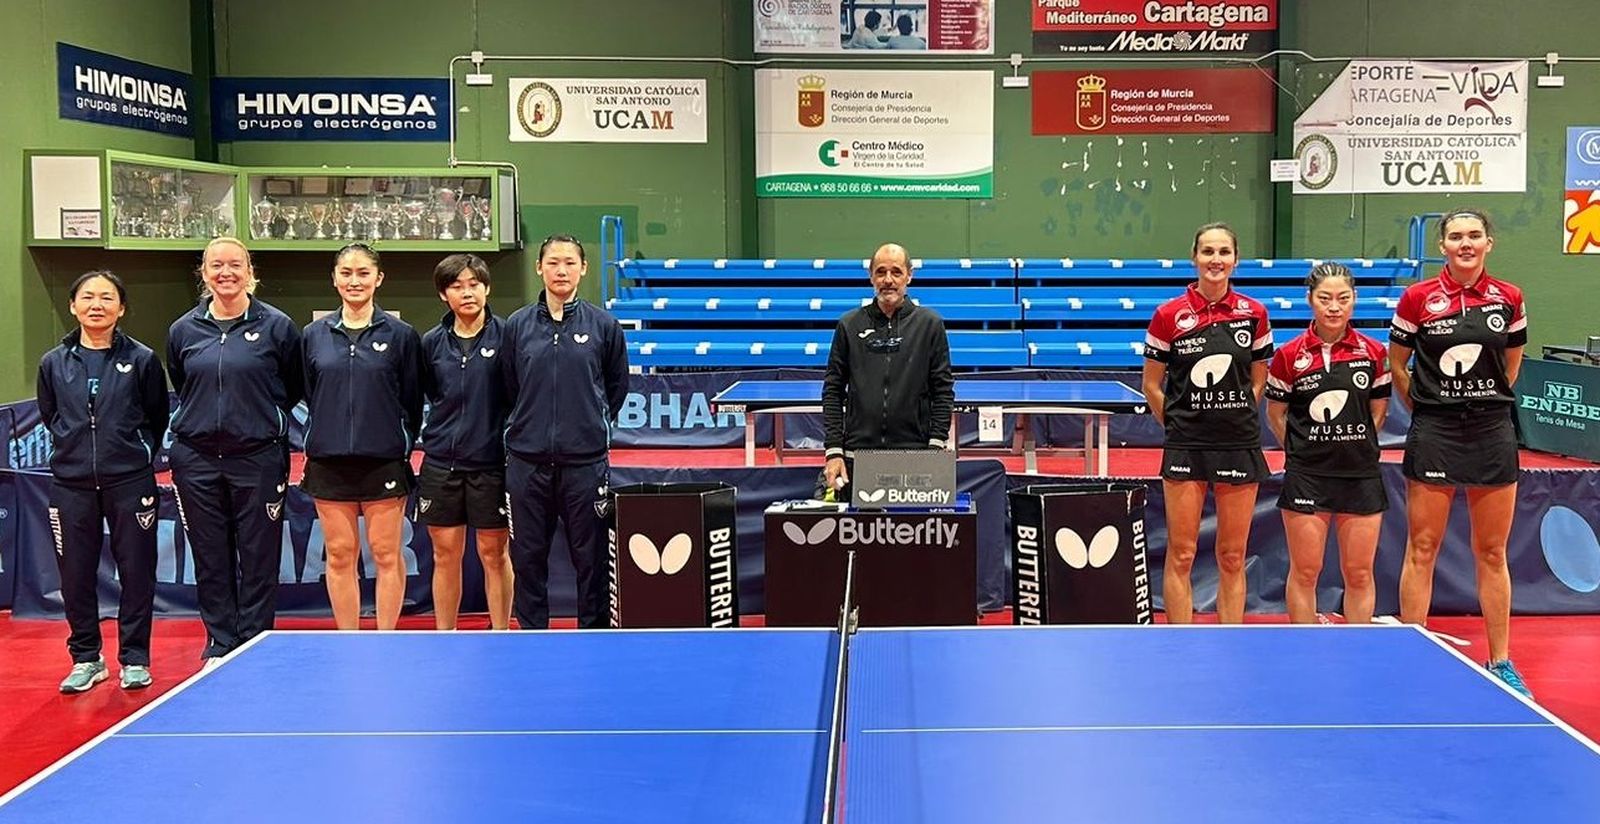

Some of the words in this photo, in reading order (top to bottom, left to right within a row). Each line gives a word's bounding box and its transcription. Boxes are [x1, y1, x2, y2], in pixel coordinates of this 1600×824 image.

[1046, 11, 1137, 24] Mediterráneo
[1144, 1, 1269, 27] Cartagena
[1107, 31, 1173, 51] Media
[1190, 31, 1247, 51] Markt
[75, 65, 187, 111] HIMOINSA
[566, 86, 642, 95] UNIVERSIDAD
[645, 85, 700, 96] CATÓLICA
[831, 90, 864, 100] Región
[866, 90, 878, 99] de
[881, 90, 913, 99] Murcia
[1110, 89, 1145, 101] Región
[1147, 89, 1159, 99] de
[1161, 89, 1193, 98] Murcia
[238, 93, 436, 116] HIMOINSA
[596, 97, 618, 105] SAN
[621, 97, 671, 106] ANTONIO
[76, 97, 117, 112] grupos
[122, 104, 188, 125] electrógenos
[831, 104, 873, 114] Consejería
[875, 104, 885, 112] de
[887, 104, 932, 113] Presidencia
[1111, 103, 1153, 113] Consejería
[1155, 103, 1165, 111] de
[1167, 103, 1213, 111] Presidencia
[238, 118, 303, 130] grupos
[313, 117, 437, 131] electrógenos
[593, 110, 674, 130] UCAM
[831, 115, 867, 124] Dirección
[870, 115, 900, 124] General
[902, 116, 912, 124] de
[914, 115, 949, 125] Deportes
[1111, 114, 1148, 123] Dirección
[1149, 114, 1181, 123] General
[1182, 114, 1193, 122] de
[1194, 114, 1230, 123] Deportes
[1429, 115, 1443, 126] de
[1448, 115, 1512, 128] Deportes
[852, 141, 886, 151] Centro
[888, 141, 924, 151] Médico
[1348, 137, 1443, 148] UNIVERSIDAD
[1447, 135, 1516, 148] CATÓLICA
[853, 152, 876, 162] Virgen
[878, 152, 887, 160] de
[1384, 150, 1412, 160] SAN
[1416, 150, 1480, 161] ANTONIO
[1381, 161, 1483, 186] UCAM
[765, 183, 812, 192] CARTAGENA
[820, 183, 835, 192] 968
[837, 183, 848, 192] 50
[1440, 378, 1495, 390] MUSEO
[1547, 384, 1579, 400] NB
[1203, 402, 1212, 410] LA
[983, 419, 996, 430] 14
[1535, 414, 1553, 425] Tenis
[1555, 417, 1564, 426] de
[1565, 419, 1585, 430] Mesa
[1310, 423, 1366, 435] MUSEO
[888, 489, 951, 504] Butterfly
[839, 517, 958, 548] Butterfly
